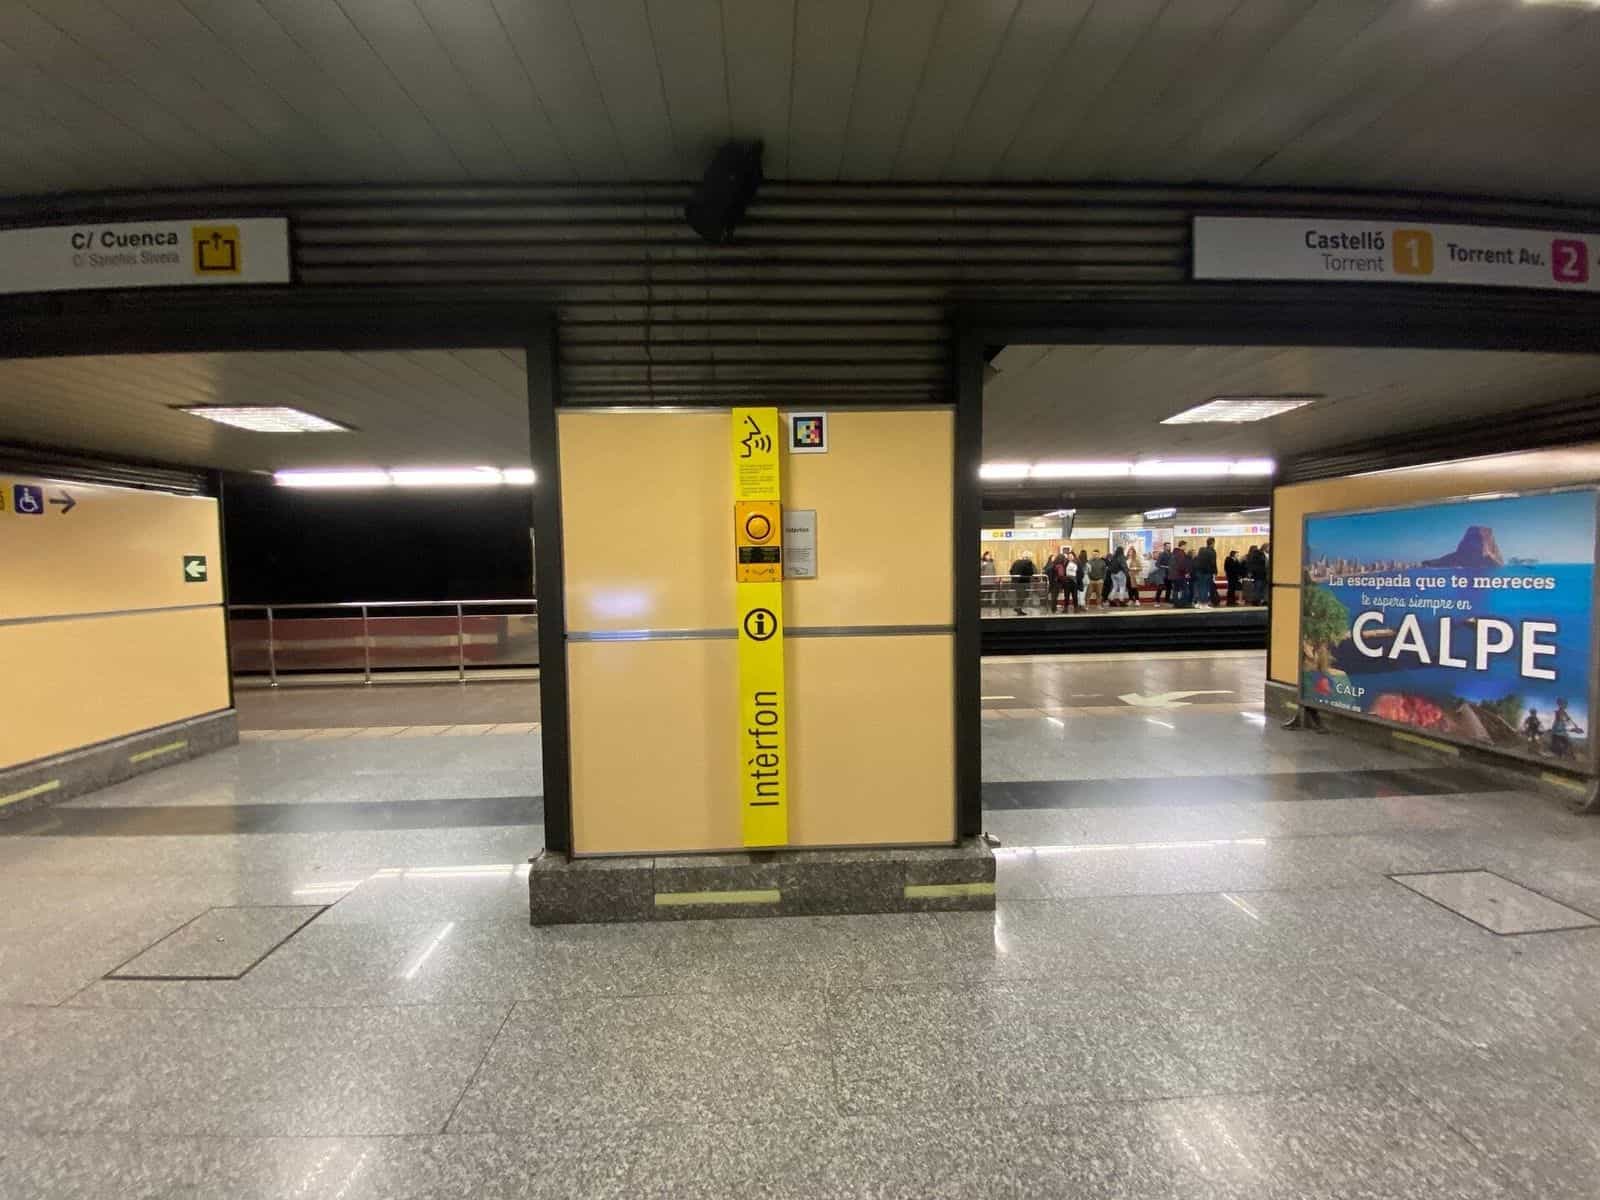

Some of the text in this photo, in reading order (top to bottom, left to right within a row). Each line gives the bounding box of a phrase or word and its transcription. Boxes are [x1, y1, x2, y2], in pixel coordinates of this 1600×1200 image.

[71, 231, 179, 250] C/ Cuenca
[1305, 230, 1420, 268] Castelló 1
[1321, 253, 1385, 272] Torrent
[1447, 243, 1579, 277] Torrent Av. 2
[1328, 574, 1557, 591] La escapada que te mereces
[1373, 596, 1406, 612] espera
[1408, 592, 1454, 616] siempre
[1456, 598, 1473, 611] en
[1351, 610, 1556, 681] CALPE
[1335, 682, 1365, 697] CALP
[748, 690, 780, 807] Intèrfon
